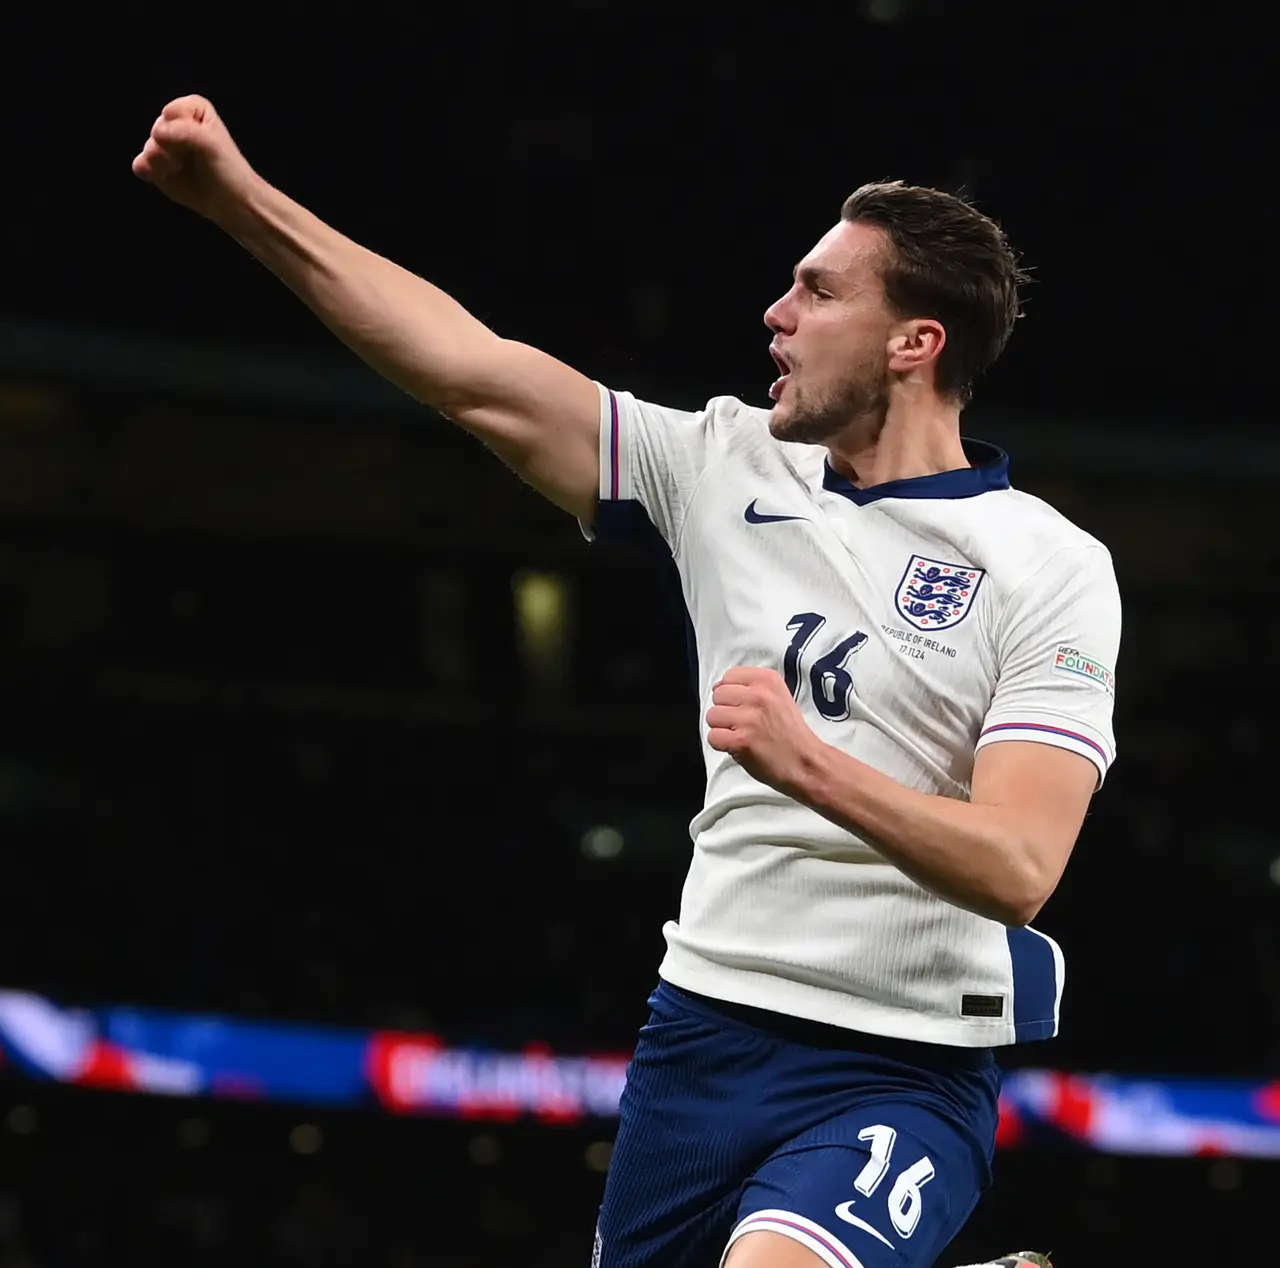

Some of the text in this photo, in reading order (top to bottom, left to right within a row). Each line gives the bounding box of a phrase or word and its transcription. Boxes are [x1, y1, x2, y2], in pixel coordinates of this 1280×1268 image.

[784, 611, 869, 722] 16
[913, 634, 924, 645] OF
[923, 638, 957, 658] IRELAND
[1058, 646, 1080, 657] UEFA
[853, 1124, 935, 1240] 16
